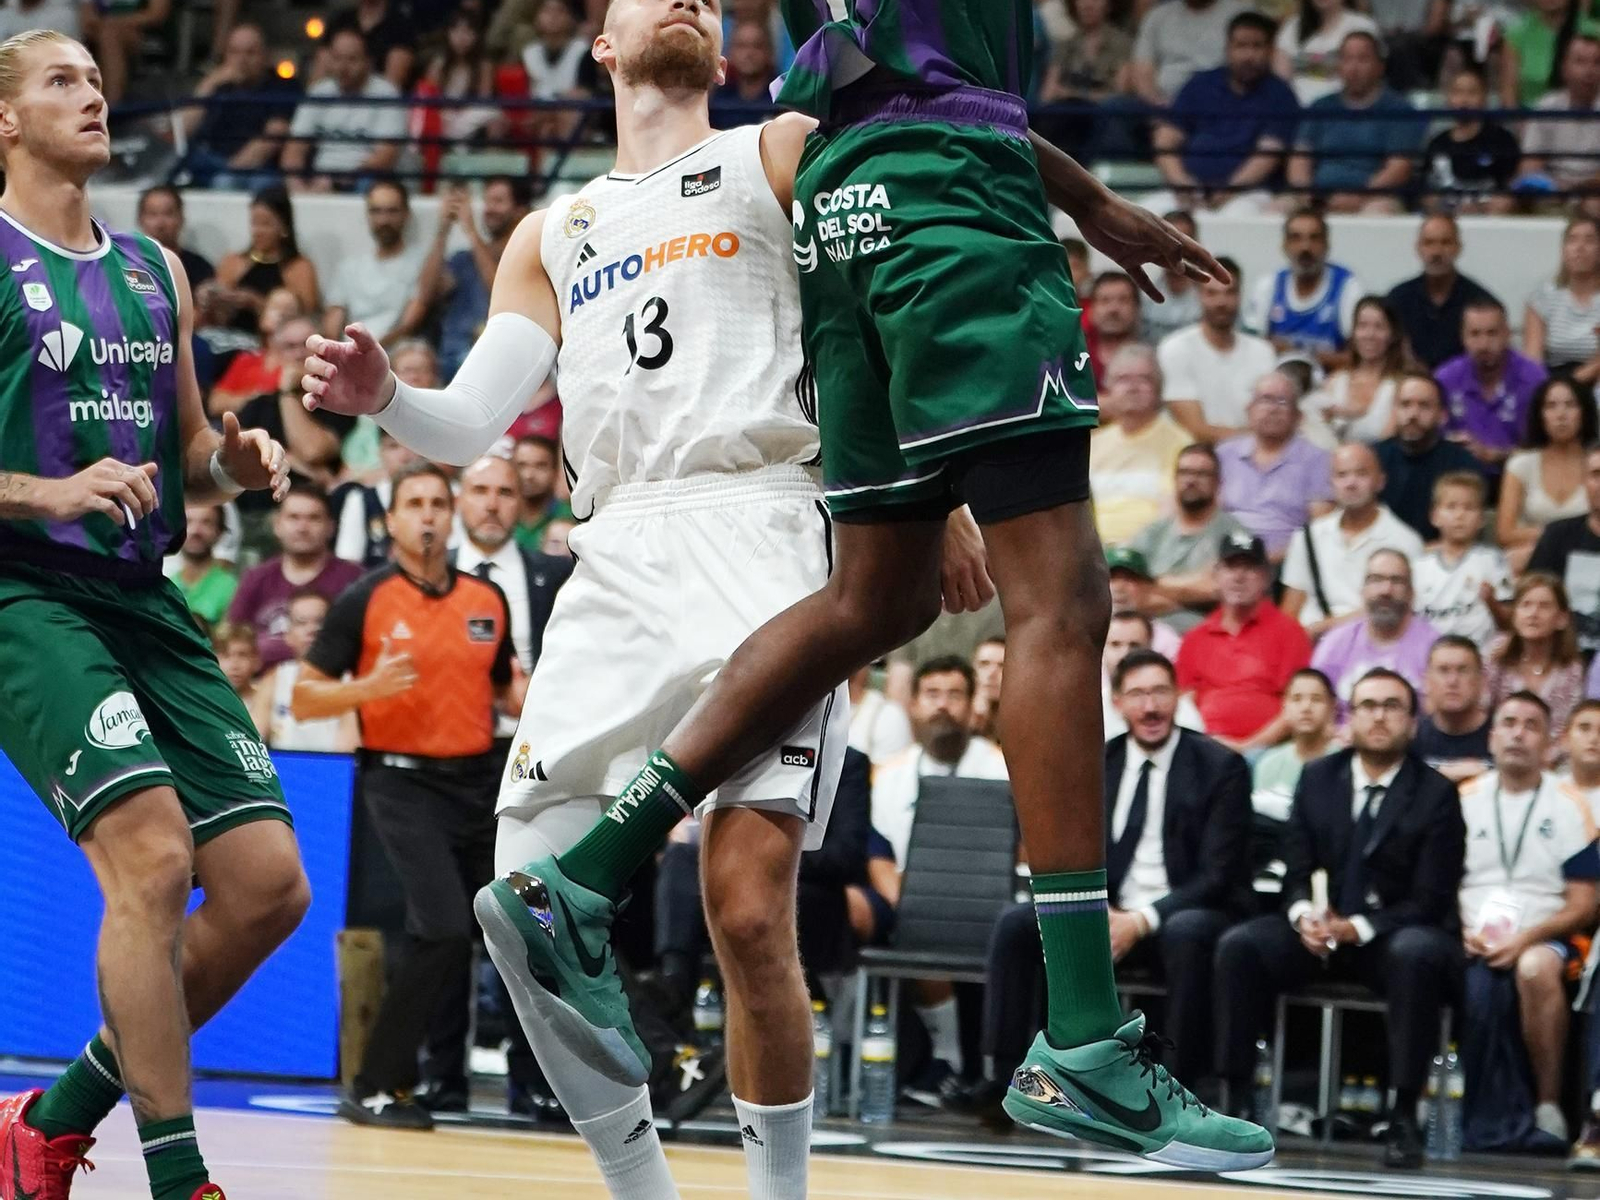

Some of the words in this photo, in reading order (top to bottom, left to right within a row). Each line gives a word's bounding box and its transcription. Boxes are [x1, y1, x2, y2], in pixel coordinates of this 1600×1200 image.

[814, 183, 892, 216] COSTA
[817, 216, 846, 242] DEL
[846, 212, 893, 235] SOL
[569, 231, 741, 315] AUTOHERO
[89, 335, 174, 371] Unicaja
[621, 296, 675, 377] 13
[783, 754, 808, 766] acb
[605, 764, 662, 825] UNICAJA
